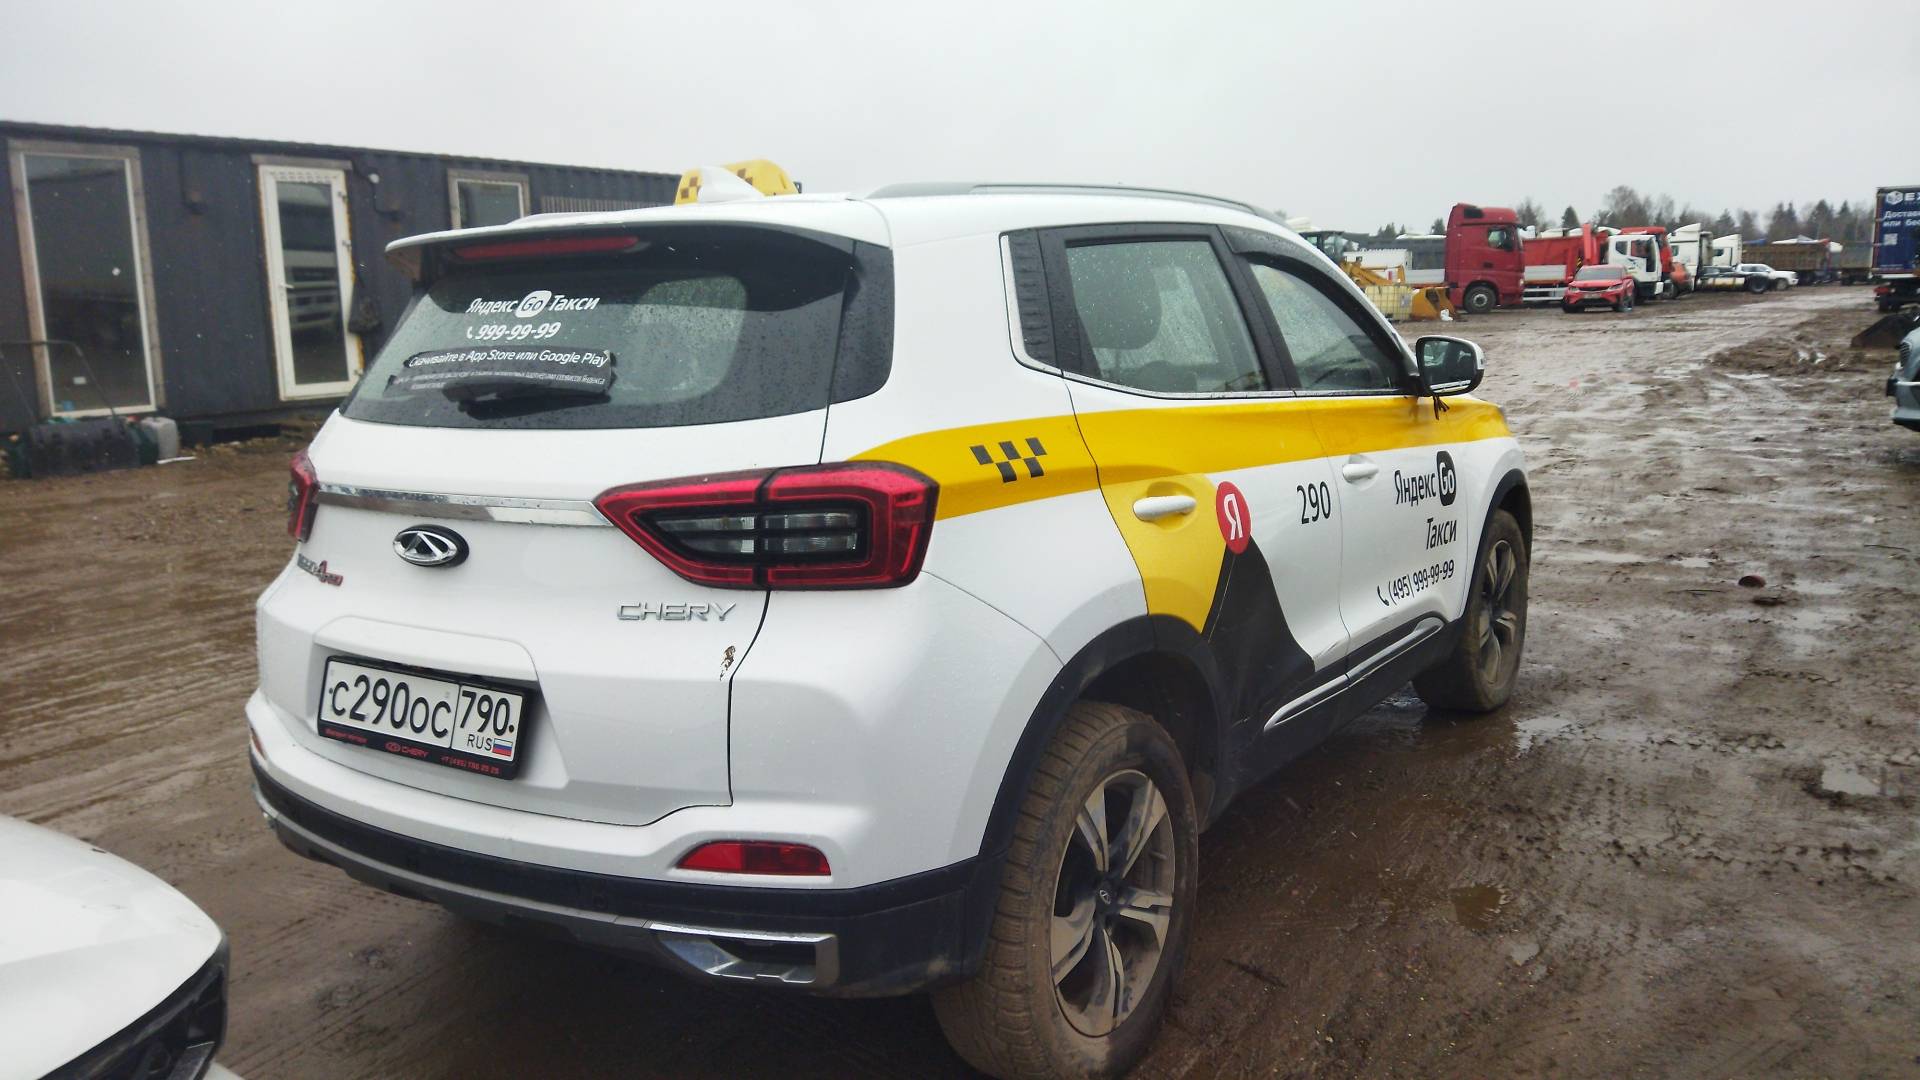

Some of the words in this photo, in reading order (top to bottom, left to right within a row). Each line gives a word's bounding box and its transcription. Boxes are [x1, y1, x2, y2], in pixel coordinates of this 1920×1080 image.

[466, 298, 518, 315] Яндекс
[548, 295, 600, 311] Такси
[475, 322, 561, 340] 999-99-99
[465, 350, 488, 363] App
[486, 349, 516, 361] Store
[515, 351, 539, 361] или
[539, 349, 581, 365] Google
[581, 352, 609, 368] Play
[1297, 481, 1331, 524] 290
[1394, 470, 1436, 507] Яндекс
[1223, 493, 1244, 541] Я
[1425, 516, 1457, 550] Такси
[1388, 574, 1415, 605] (495)
[1413, 559, 1455, 593] 999-99-99
[617, 602, 736, 621] CHERY
[459, 690, 510, 736] 790
[467, 733, 492, 751] RUS
